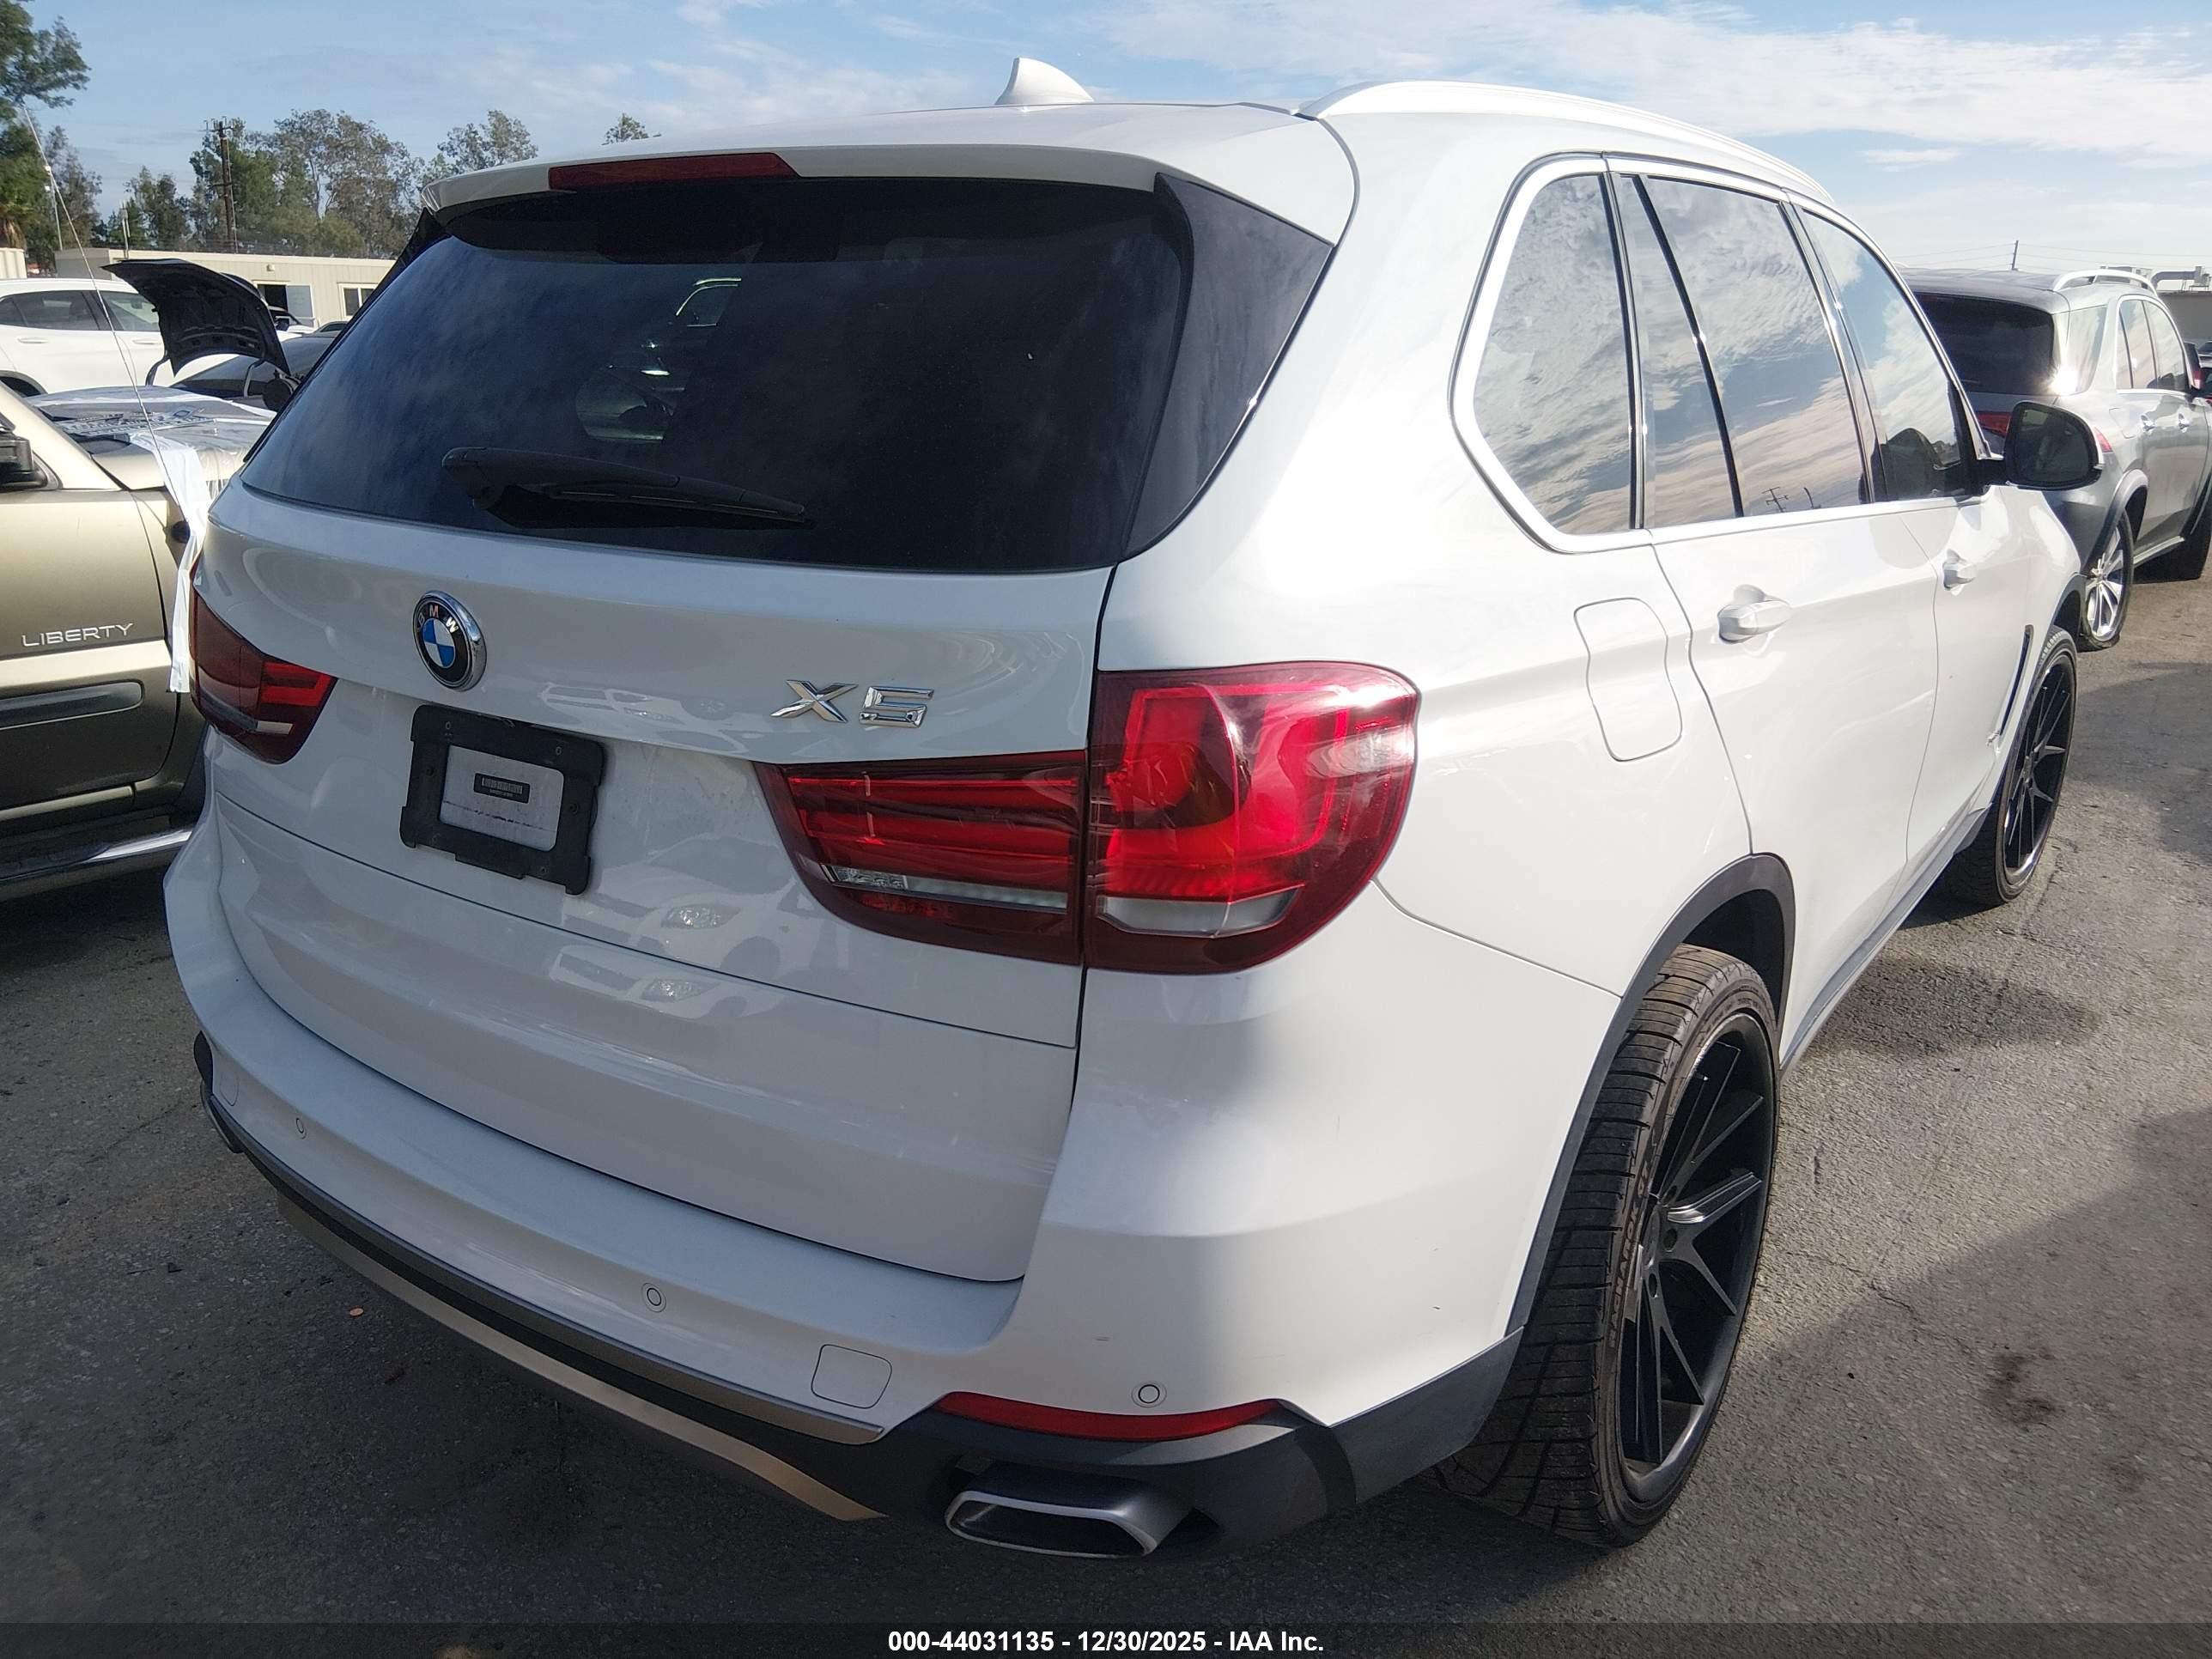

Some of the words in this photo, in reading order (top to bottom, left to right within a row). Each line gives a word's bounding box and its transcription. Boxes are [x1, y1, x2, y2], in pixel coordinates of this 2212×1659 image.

[418, 604, 459, 634] BMW
[21, 623, 134, 647] LIBERTY
[769, 678, 935, 728] X5
